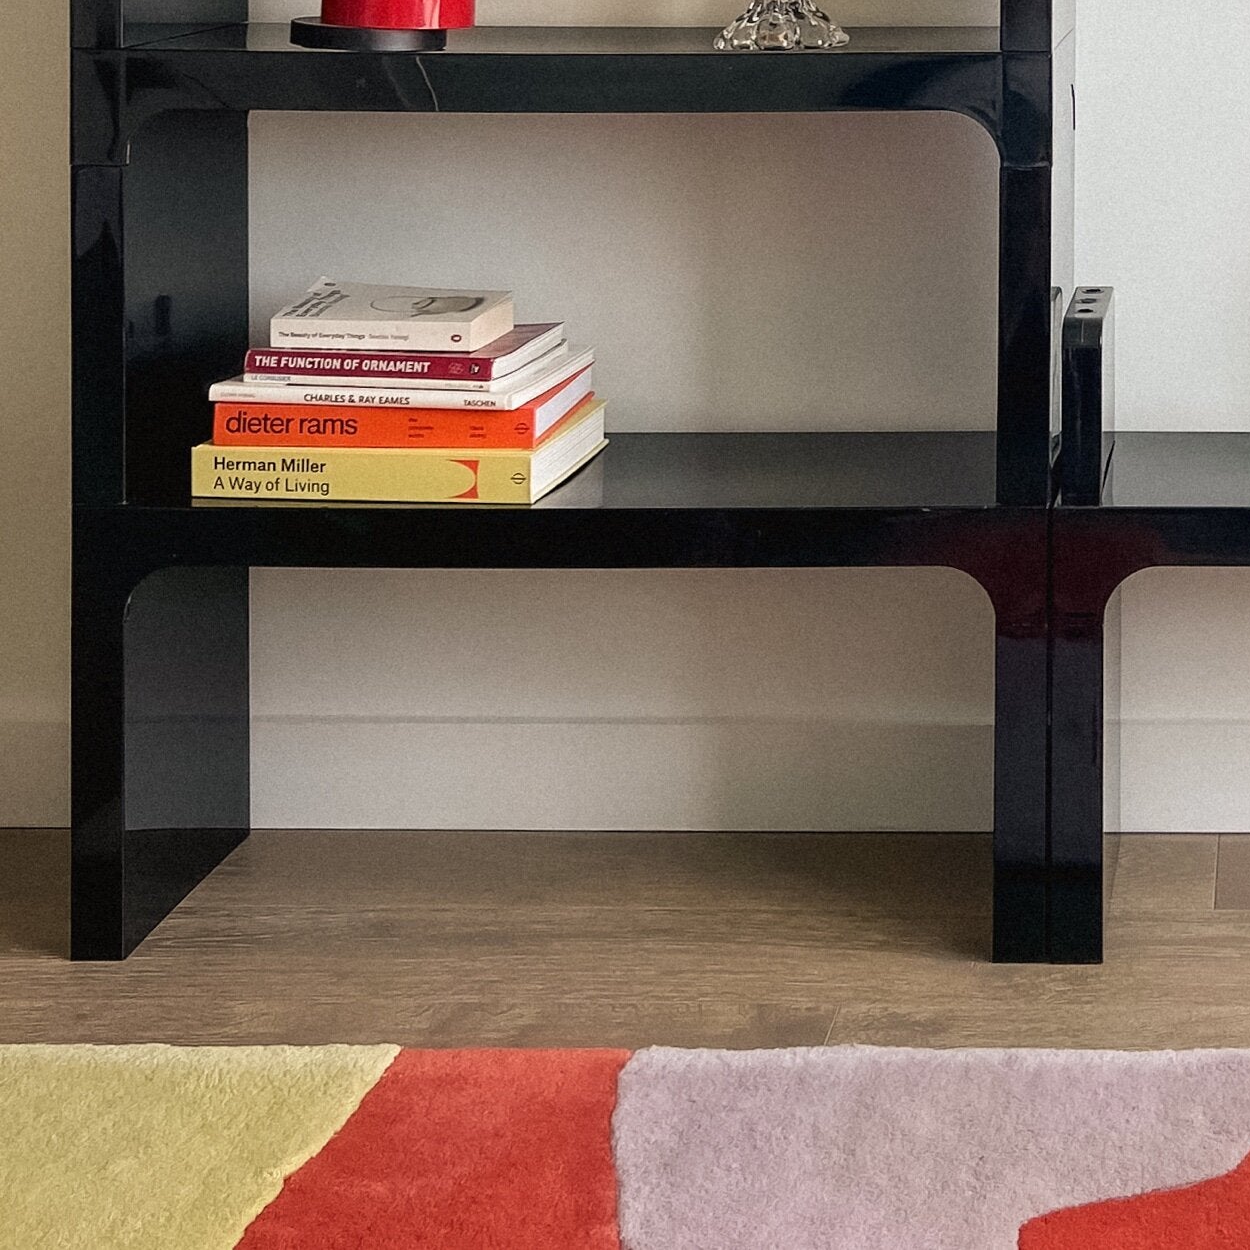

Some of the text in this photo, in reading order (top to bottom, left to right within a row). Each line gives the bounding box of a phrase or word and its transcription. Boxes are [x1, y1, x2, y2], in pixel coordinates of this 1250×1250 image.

[254, 355, 431, 373] THE FUNCTION OF ORNAMENT
[303, 393, 411, 406] CHARLES & RAY EAMES
[463, 399, 497, 408] TASCHEN
[225, 410, 358, 435] dieter rams
[213, 456, 327, 473] Herman Miller
[213, 476, 330, 496] A Way of Living
